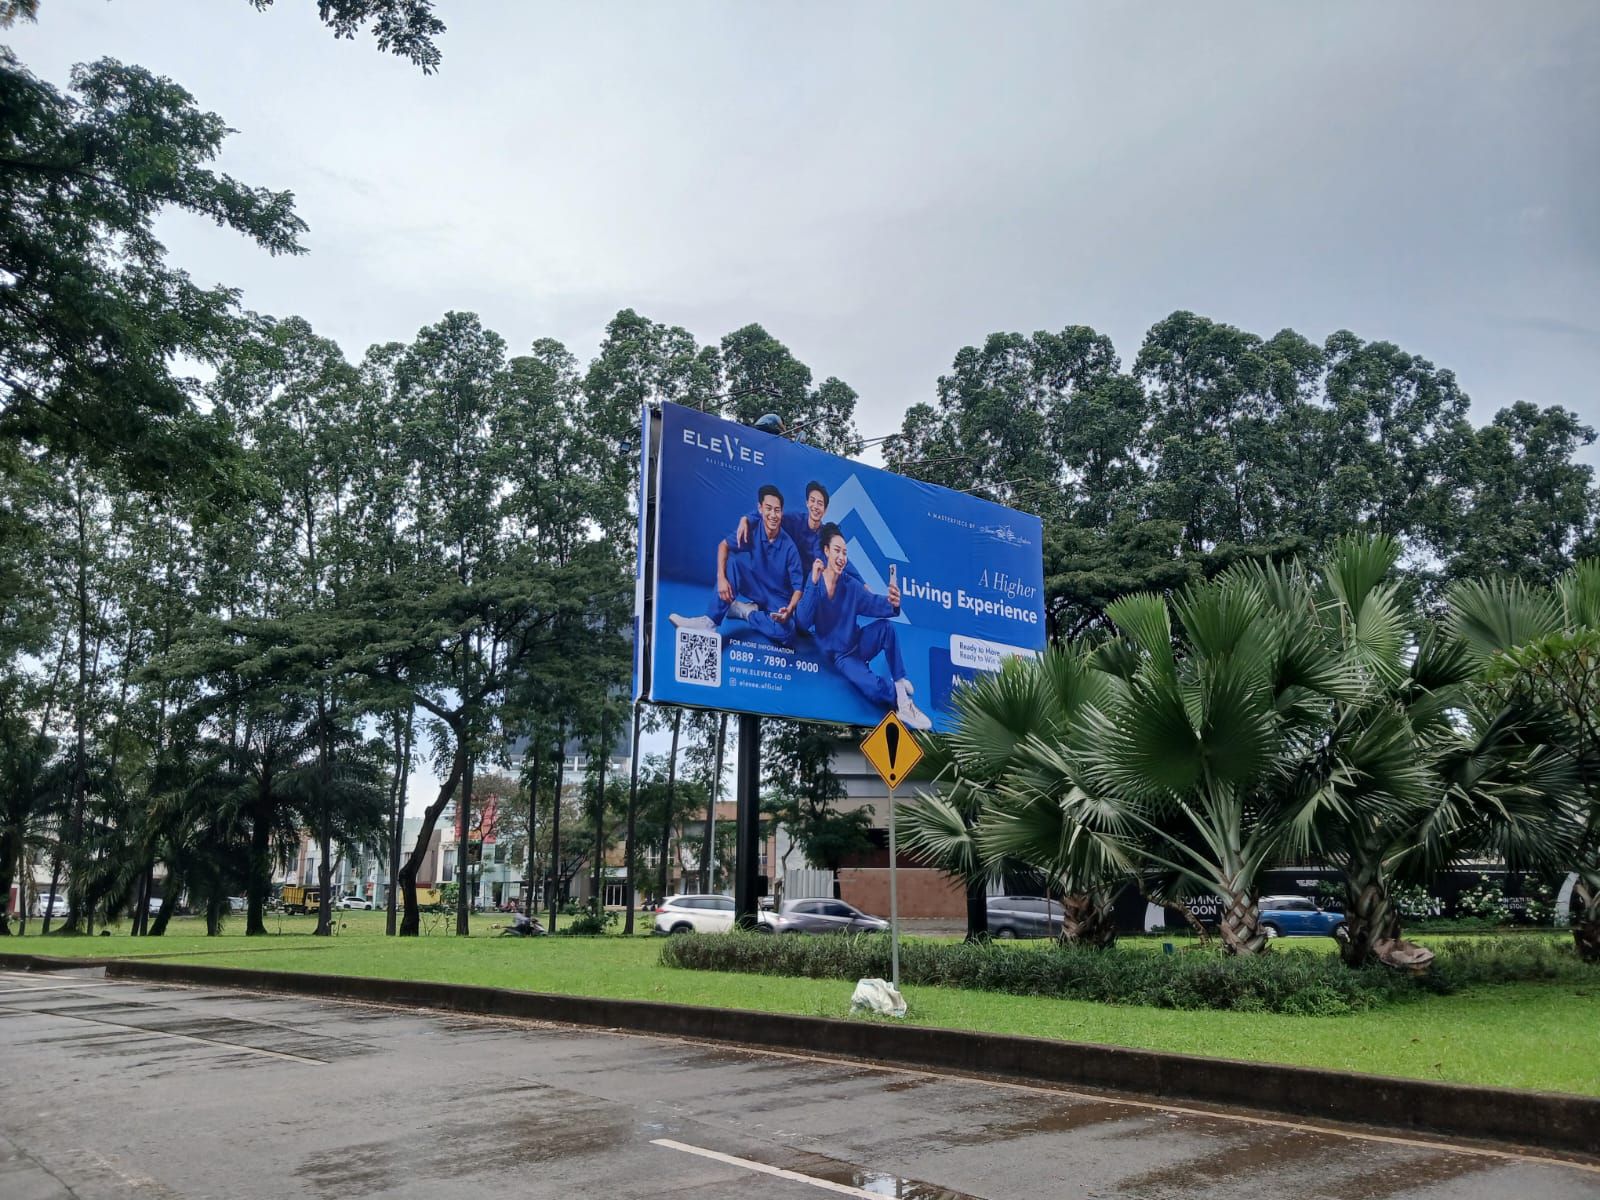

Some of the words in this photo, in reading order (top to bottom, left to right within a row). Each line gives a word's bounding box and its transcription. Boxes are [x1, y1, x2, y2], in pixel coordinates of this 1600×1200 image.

[683, 429, 764, 466] ELEVEE
[978, 568, 988, 588] A
[993, 572, 1036, 598] Higher
[902, 576, 952, 609] Living
[957, 590, 1038, 624] Experience
[758, 644, 794, 654] INFORMATION
[960, 642, 976, 652] Ready
[730, 650, 754, 663] 0889
[764, 656, 786, 668] 7890
[796, 660, 818, 672] 9000
[960, 651, 976, 662] Ready
[729, 666, 792, 680] WWW.ELEVEE.CO.ID
